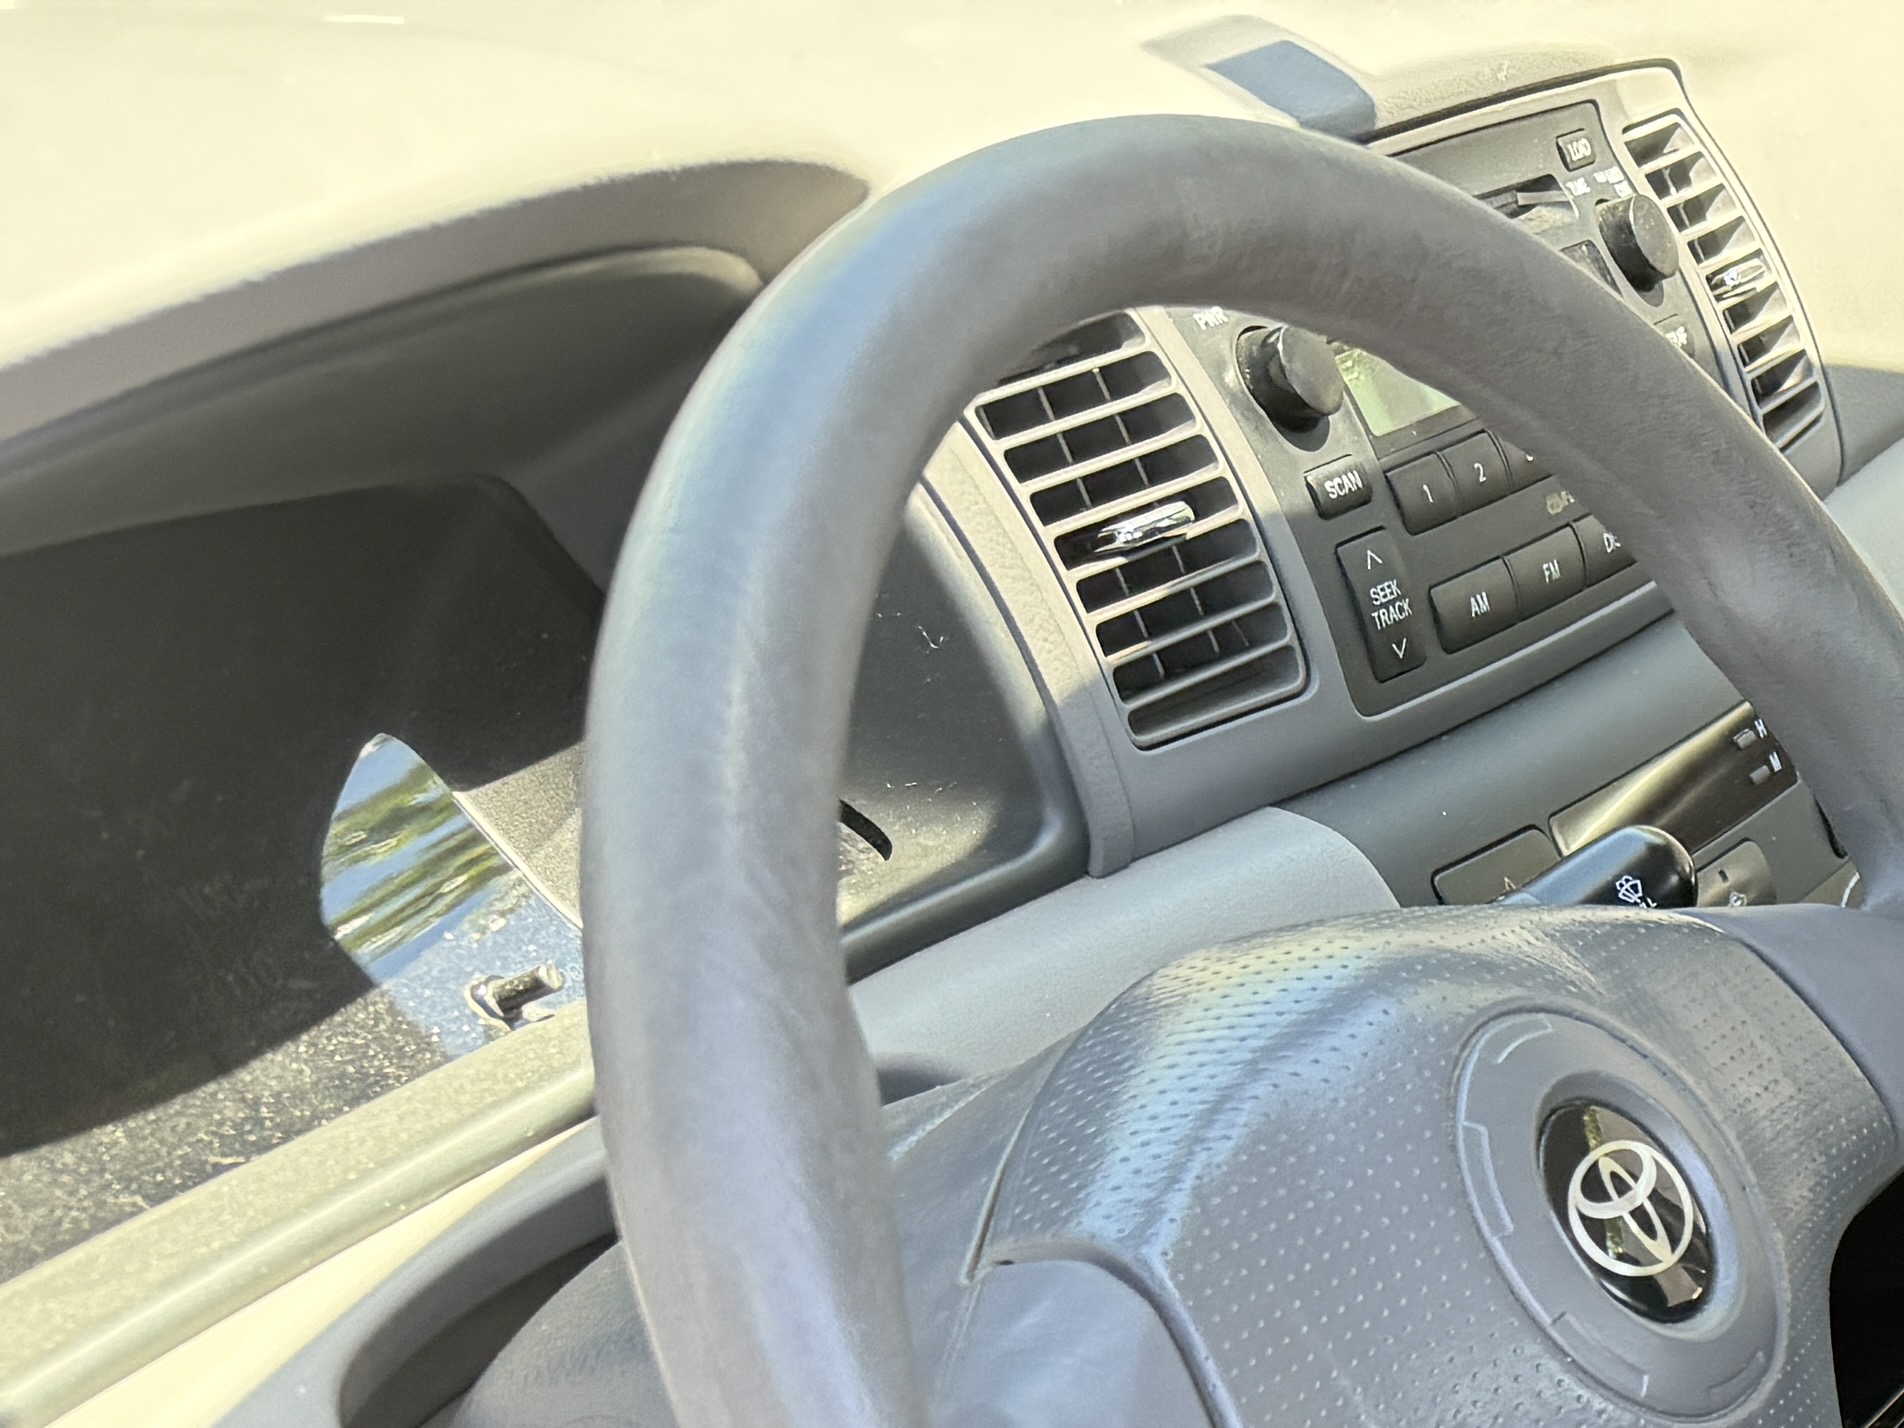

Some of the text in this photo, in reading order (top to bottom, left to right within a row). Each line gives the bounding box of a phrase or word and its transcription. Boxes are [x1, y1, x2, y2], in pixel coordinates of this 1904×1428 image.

[1193, 305, 1229, 331] PWR
[1324, 470, 1364, 500] SCAN
[1474, 462, 1487, 483] 2
[1422, 484, 1434, 503] 1
[1542, 559, 1561, 584] FM
[1369, 578, 1402, 606] SEEK
[1470, 591, 1491, 618] AM
[1371, 597, 1413, 631] TRACK
[1754, 718, 1768, 738] H
